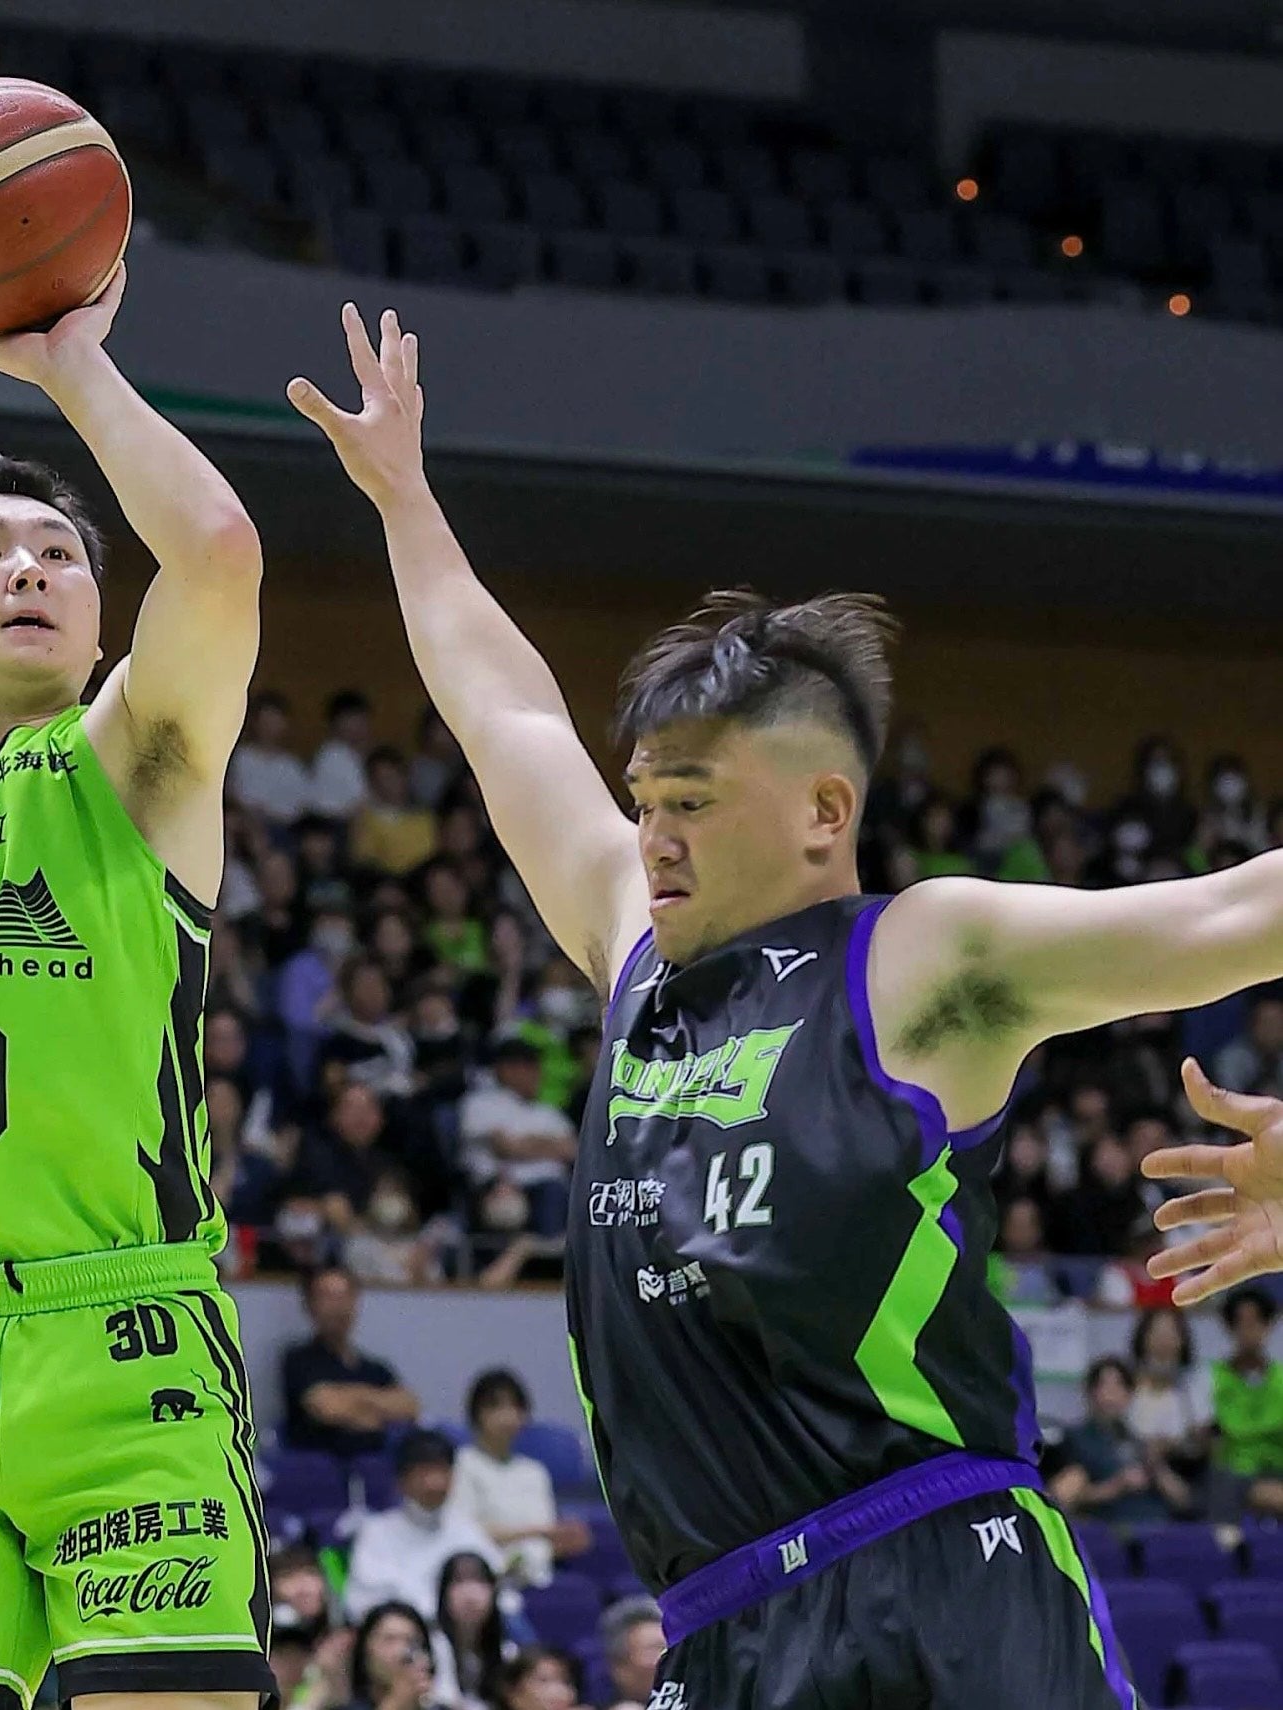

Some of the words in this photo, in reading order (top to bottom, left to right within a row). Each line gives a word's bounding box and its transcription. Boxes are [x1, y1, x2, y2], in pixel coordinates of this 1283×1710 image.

[703, 1142, 777, 1235] 42
[106, 1303, 178, 1362] 30
[75, 1555, 219, 1623] Coca-Cola
